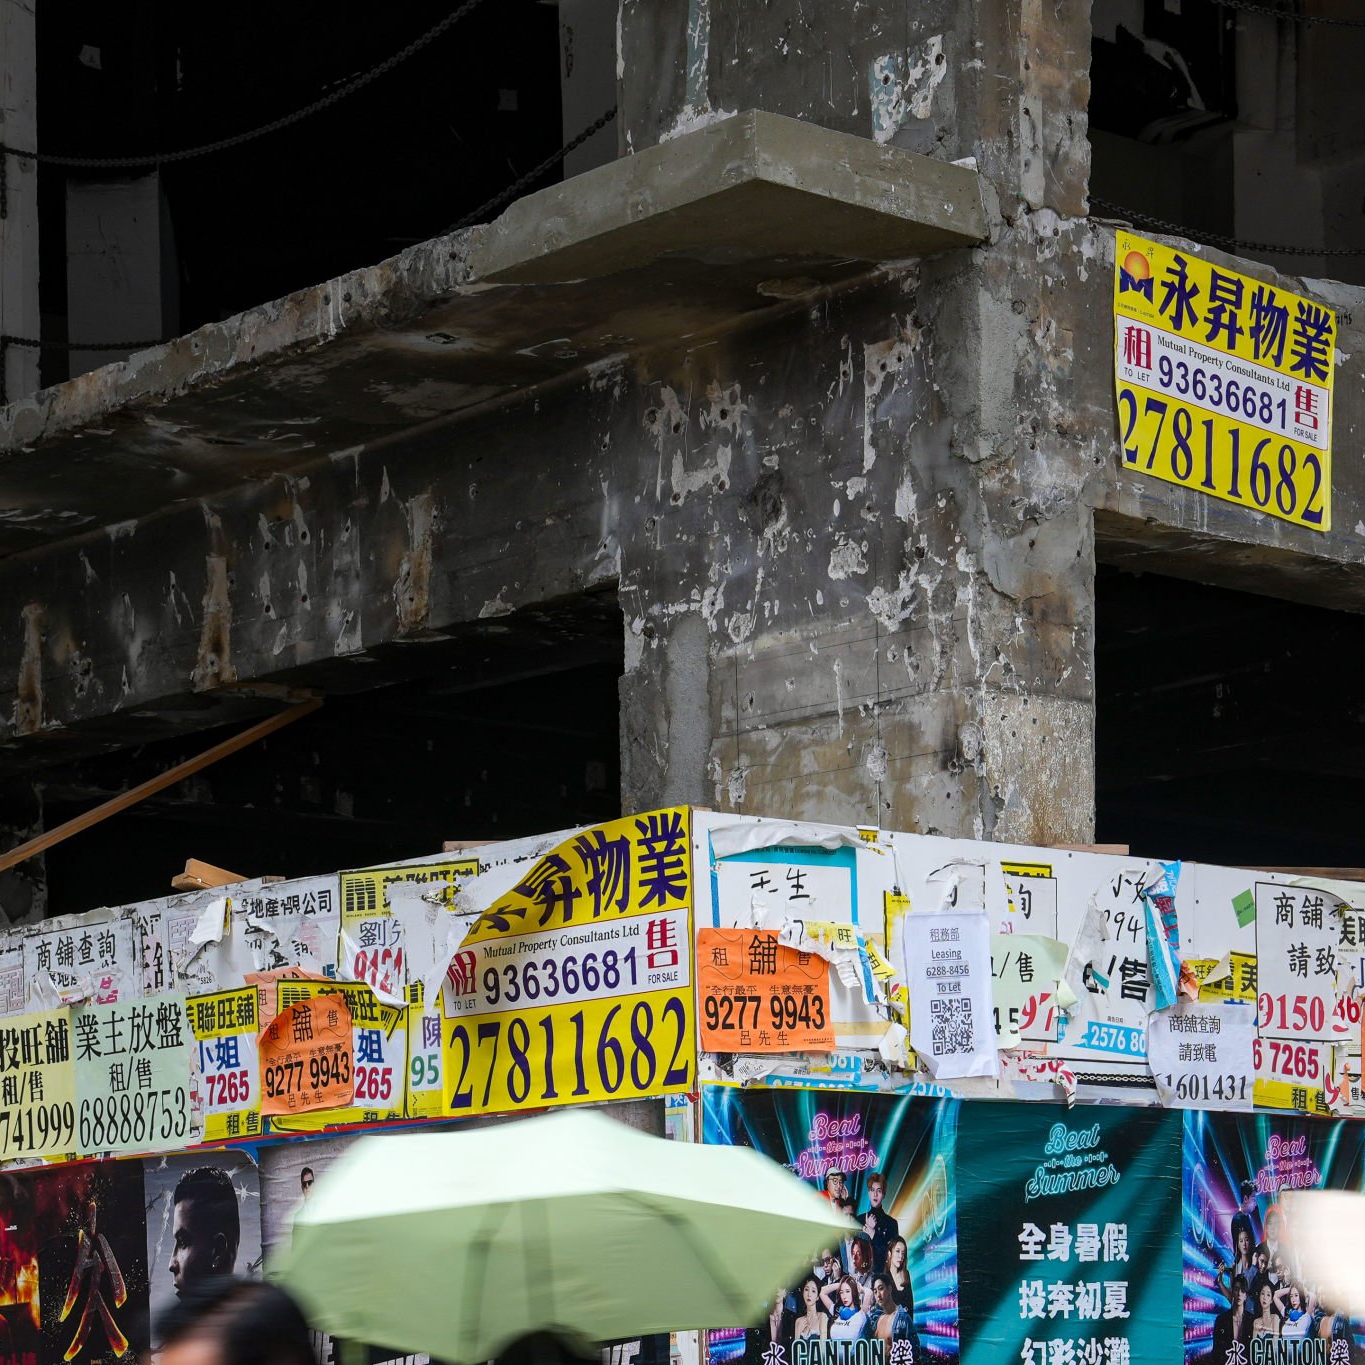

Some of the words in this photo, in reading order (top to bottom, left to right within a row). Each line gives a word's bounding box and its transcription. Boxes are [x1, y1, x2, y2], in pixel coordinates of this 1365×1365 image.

[1158, 254, 1333, 380] 永昇物業
[1123, 325, 1152, 370] 租
[1158, 335, 1186, 354] Mutual
[1189, 347, 1224, 369] Property
[1225, 361, 1275, 385] Consultants
[1276, 376, 1290, 391] Ltd
[1124, 367, 1133, 377] TO
[1138, 369, 1150, 382] LET
[1159, 355, 1286, 429] 93636681
[1295, 385, 1318, 429] 售
[1294, 427, 1304, 437] FOR
[1305, 430, 1317, 442] SALE
[1119, 388, 1323, 524] 27811682
[483, 939, 516, 959] Mutual
[518, 938, 558, 956] Property
[560, 928, 621, 947] Consultants
[622, 924, 640, 937] Ltd
[646, 917, 679, 969] 售
[930, 928, 960, 941] 租務部
[926, 964, 970, 976] 6288-8456
[931, 949, 962, 960] Leasing
[483, 946, 637, 1005] 93636681
[647, 973, 661, 984] FOR
[662, 972, 678, 982] SALE
[936, 982, 946, 993] To
[947, 982, 961, 993] Let
[454, 1000, 462, 1010] TO
[465, 998, 477, 1009] LET
[704, 995, 761, 1030] 9277
[770, 995, 826, 1031] 9943
[1259, 993, 1324, 1032] 9150
[75, 1001, 185, 1062] 業主放盤
[740, 1030, 789, 1046] 呂先生
[1168, 1014, 1220, 1034] 商舖查詢
[449, 996, 689, 1109] 27811682
[1179, 1042, 1217, 1063] 請致電
[1269, 1041, 1319, 1080] 7265
[2, 1071, 44, 1107] 租/售
[109, 1056, 152, 1094] 租/售
[206, 1069, 249, 1106] 7265
[265, 1061, 304, 1098] 9277
[310, 1051, 350, 1090] 9943
[79, 1087, 186, 1149] 68888753
[287, 1090, 324, 1109] 呂先生
[1044, 1122, 1100, 1154] Beat
[1063, 1155, 1082, 1167] the
[1026, 1165, 1120, 1203] Summer
[1017, 1222, 1130, 1263] 全身暑假
[1019, 1280, 1130, 1320] 投奔初夏
